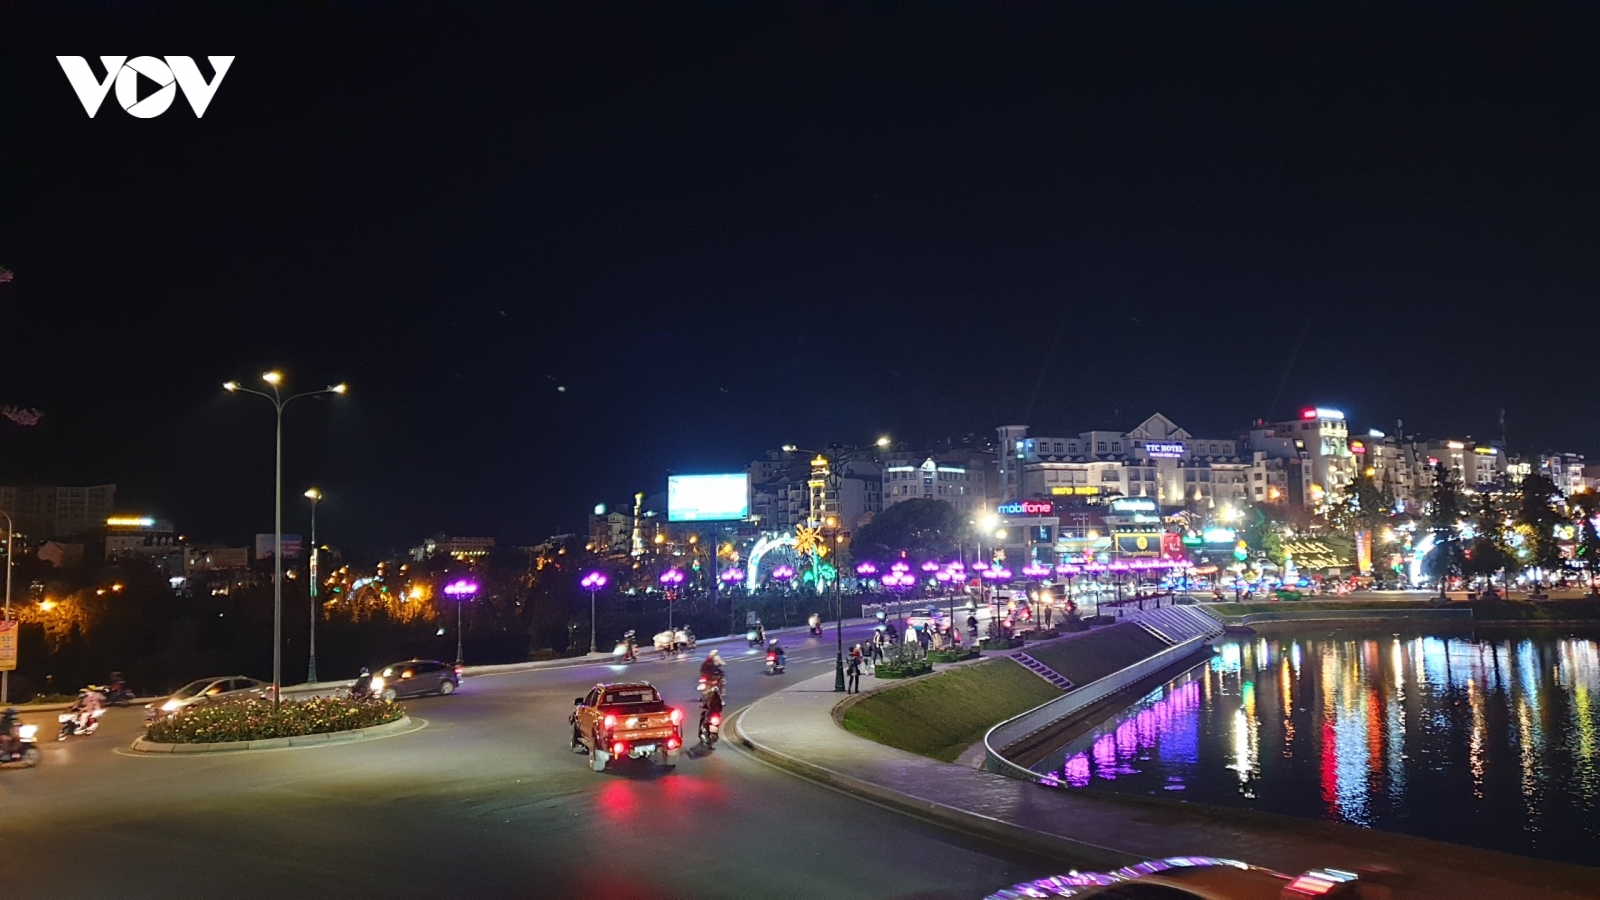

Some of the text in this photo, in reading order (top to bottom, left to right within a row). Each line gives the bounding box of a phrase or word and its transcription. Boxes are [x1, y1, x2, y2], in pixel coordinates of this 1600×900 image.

[1146, 444, 1184, 453] TTC HOTEL
[998, 502, 1051, 514] mobifone
